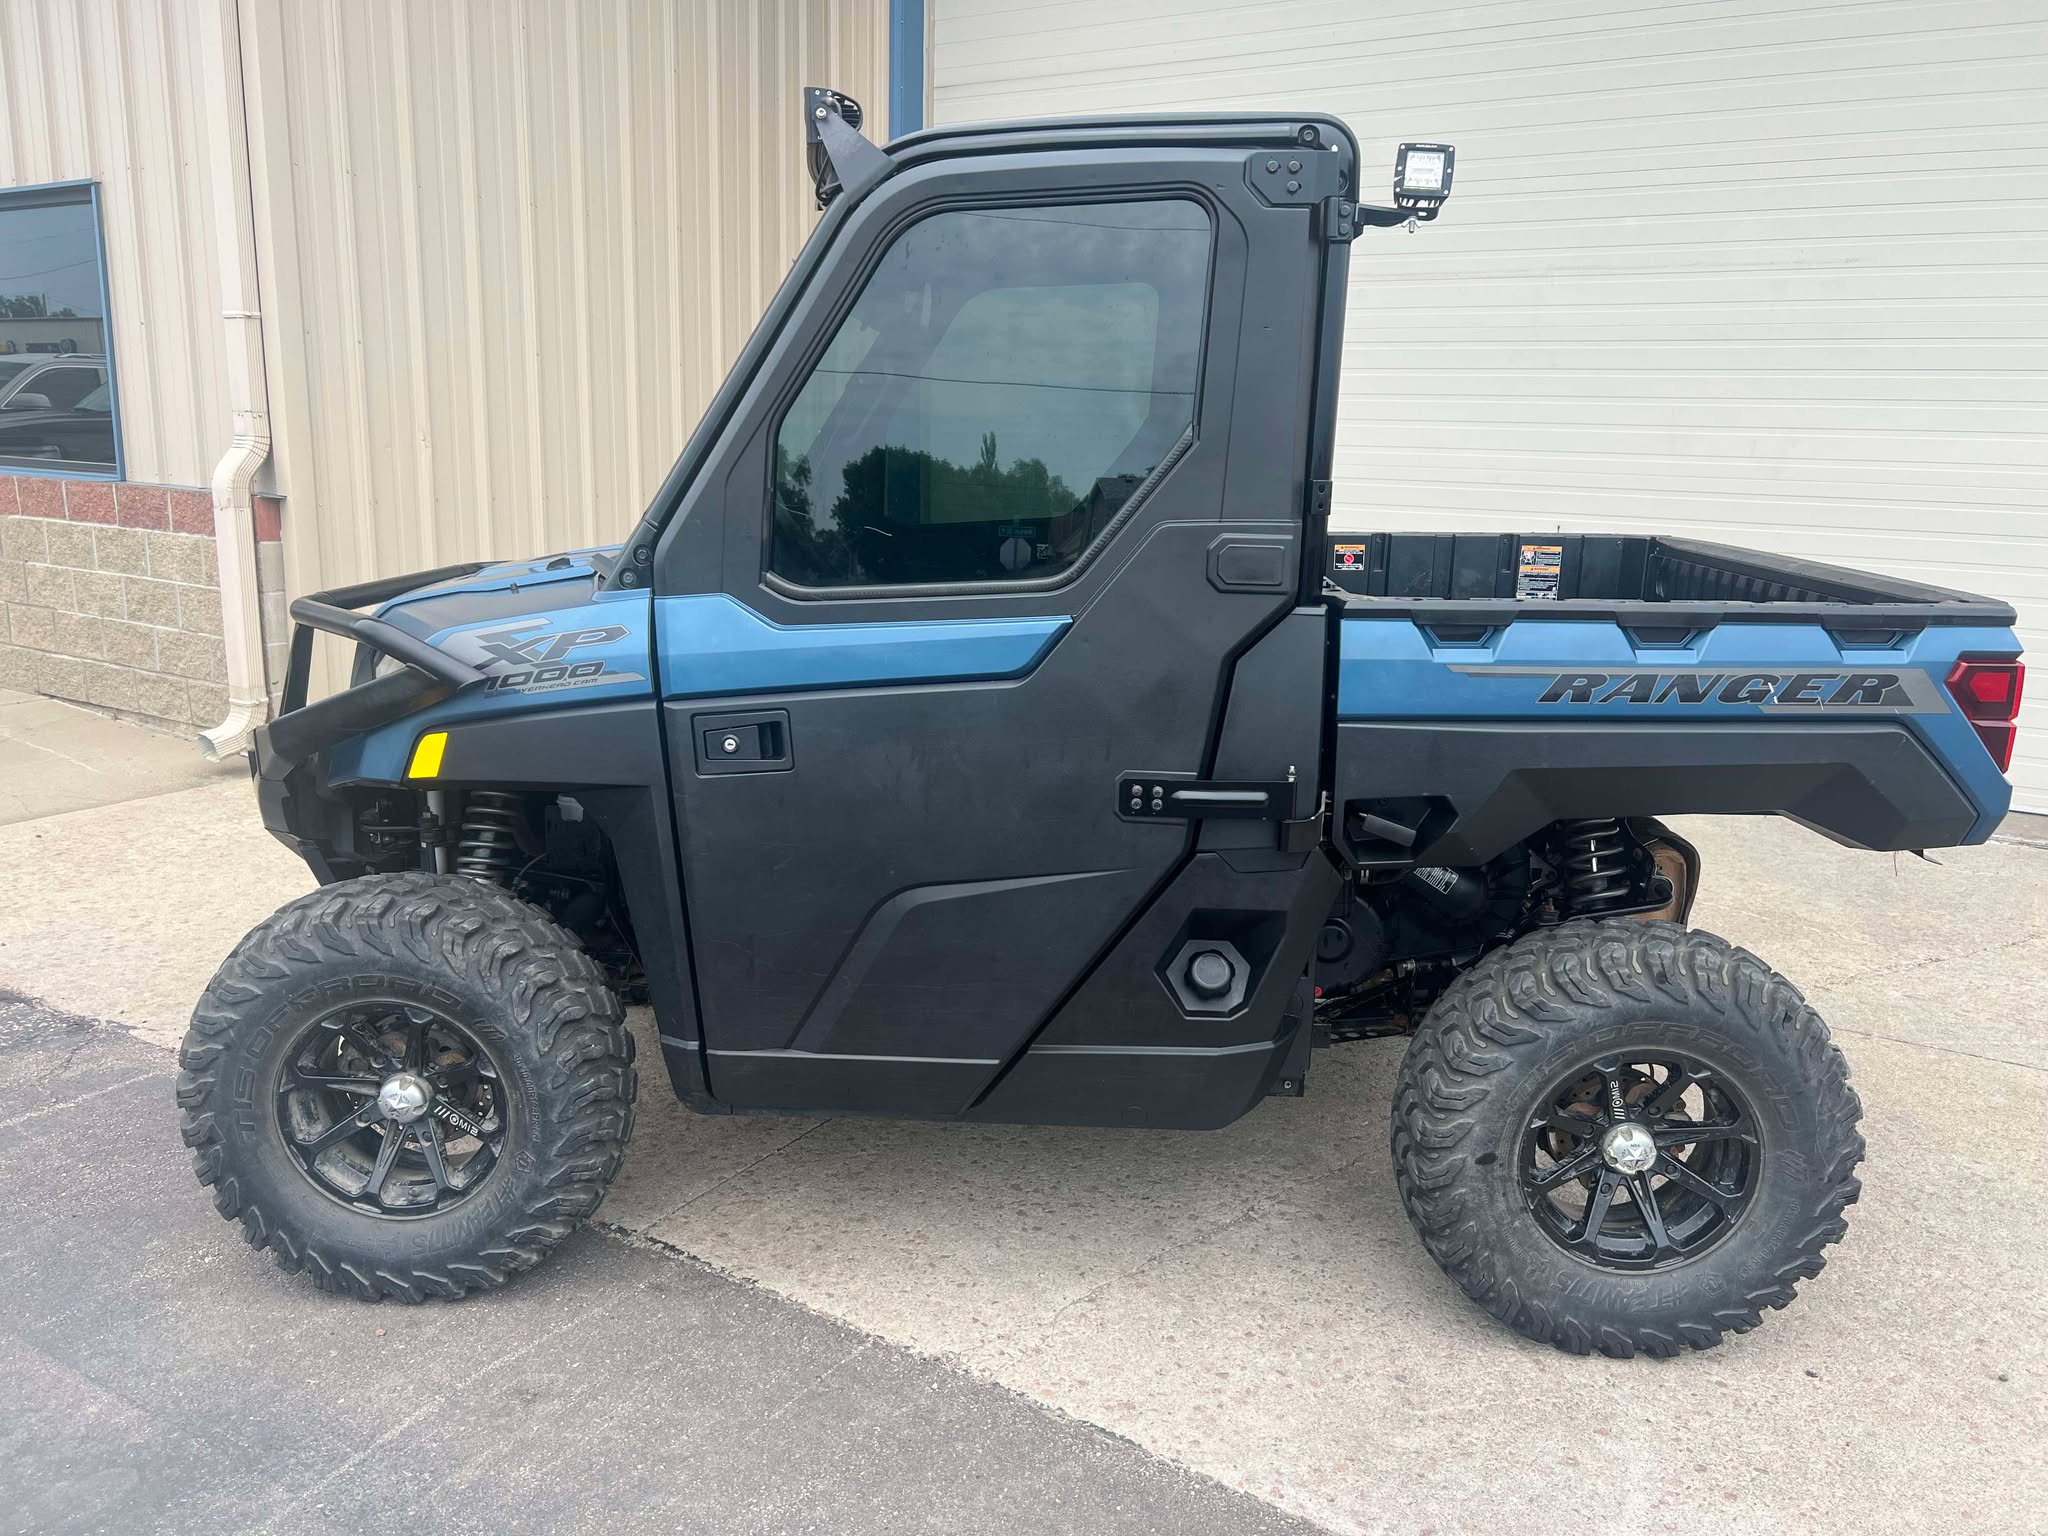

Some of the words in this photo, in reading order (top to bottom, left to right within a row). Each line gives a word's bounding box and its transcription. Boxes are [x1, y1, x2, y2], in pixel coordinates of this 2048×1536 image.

[473, 624, 631, 671] XP
[484, 660, 606, 692] 1000
[517, 682, 571, 693] VERHEAD
[1536, 673, 1914, 706] RANGER
